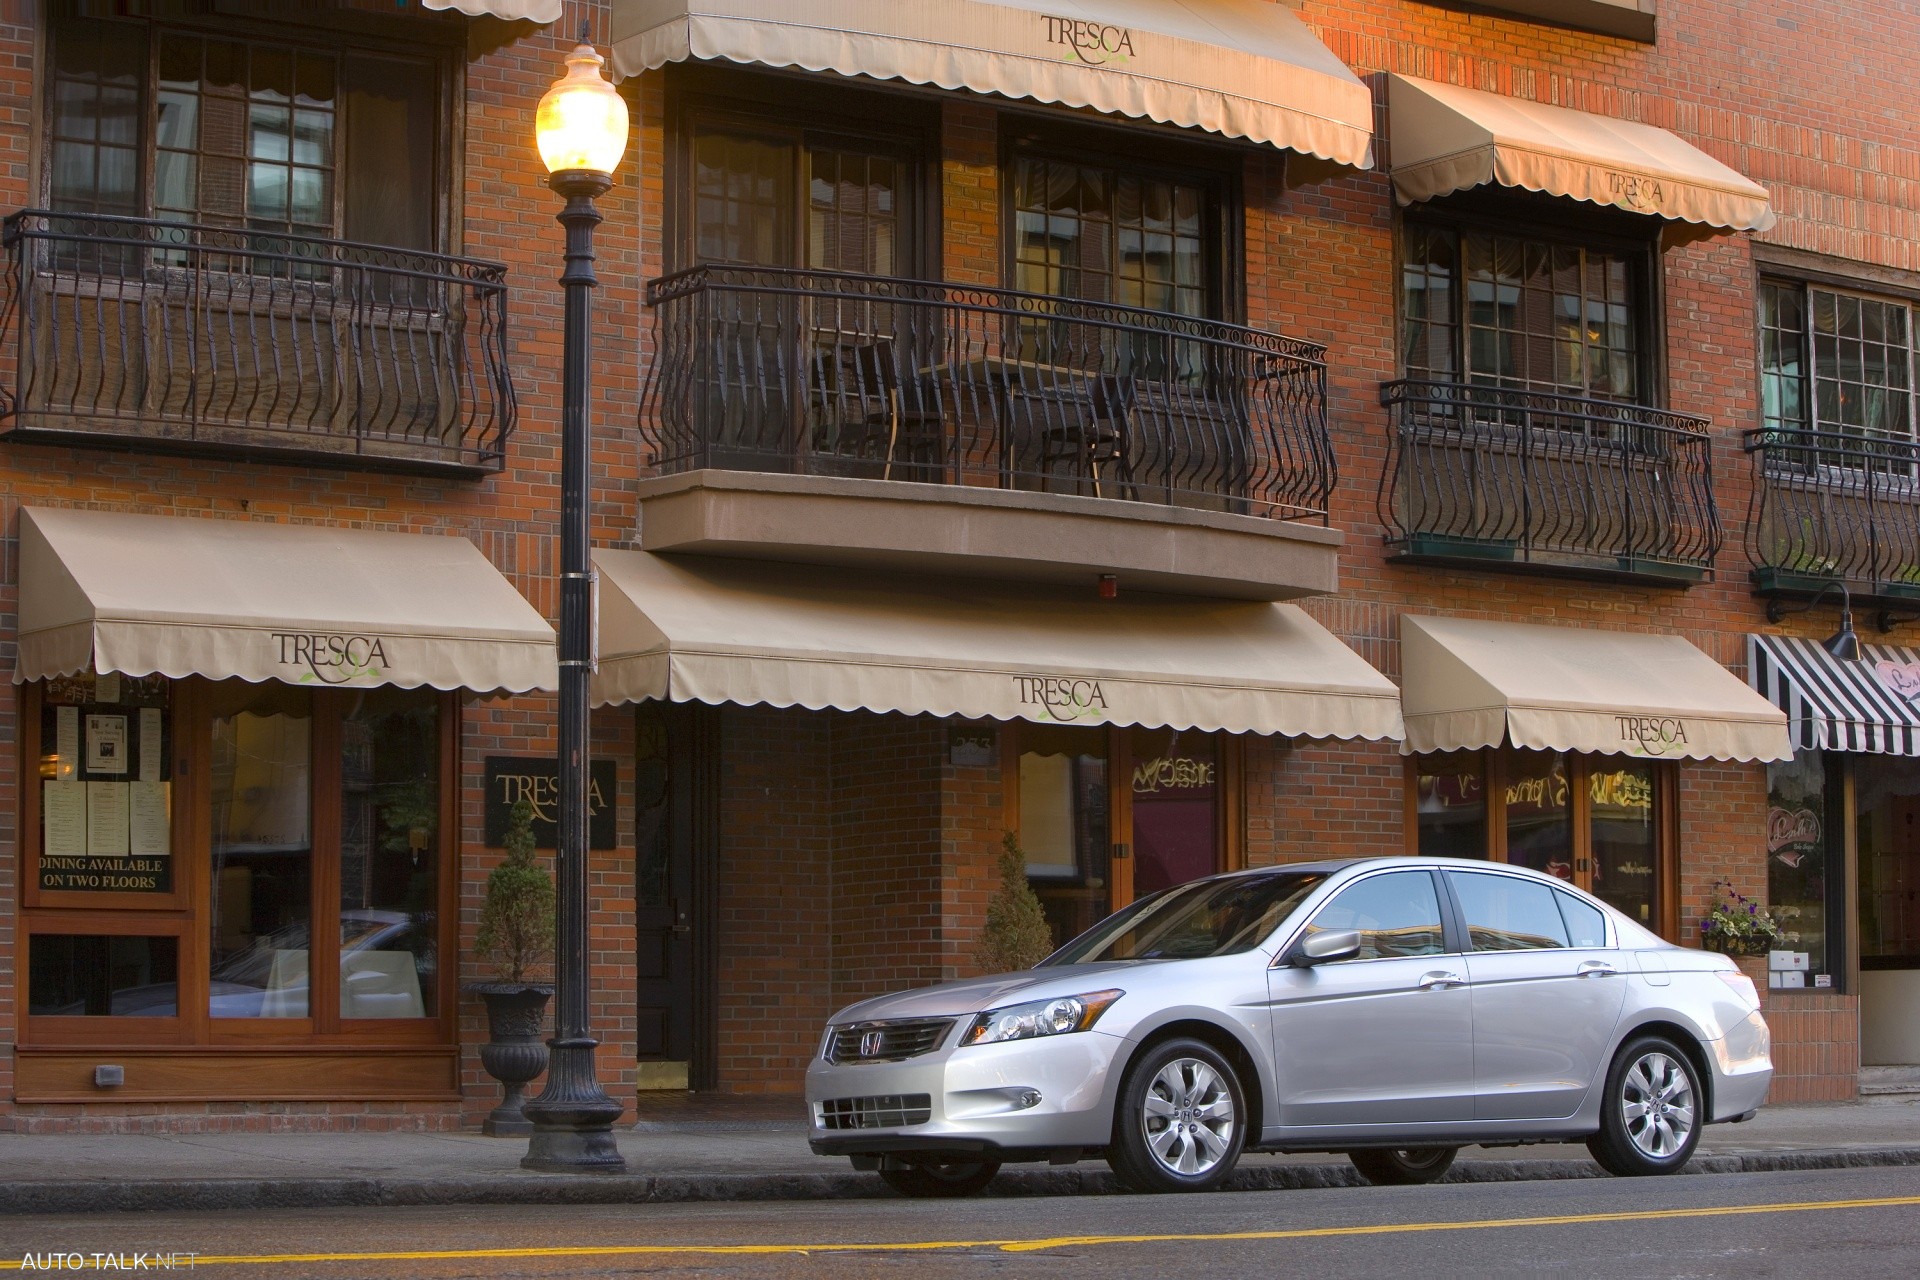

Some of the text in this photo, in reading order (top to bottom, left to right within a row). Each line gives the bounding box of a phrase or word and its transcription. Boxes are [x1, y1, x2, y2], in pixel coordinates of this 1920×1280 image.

[1041, 15, 1136, 65] TRESCA
[1605, 172, 1664, 209] TRESCA
[272, 633, 391, 684] TRESCA
[1013, 676, 1109, 721] TRESCA
[1615, 716, 1688, 755] TRESCA
[496, 774, 608, 823] TRESA
[39, 857, 163, 872] DINING AVAILABLE
[44, 874, 156, 888] ON TWO FLOORS
